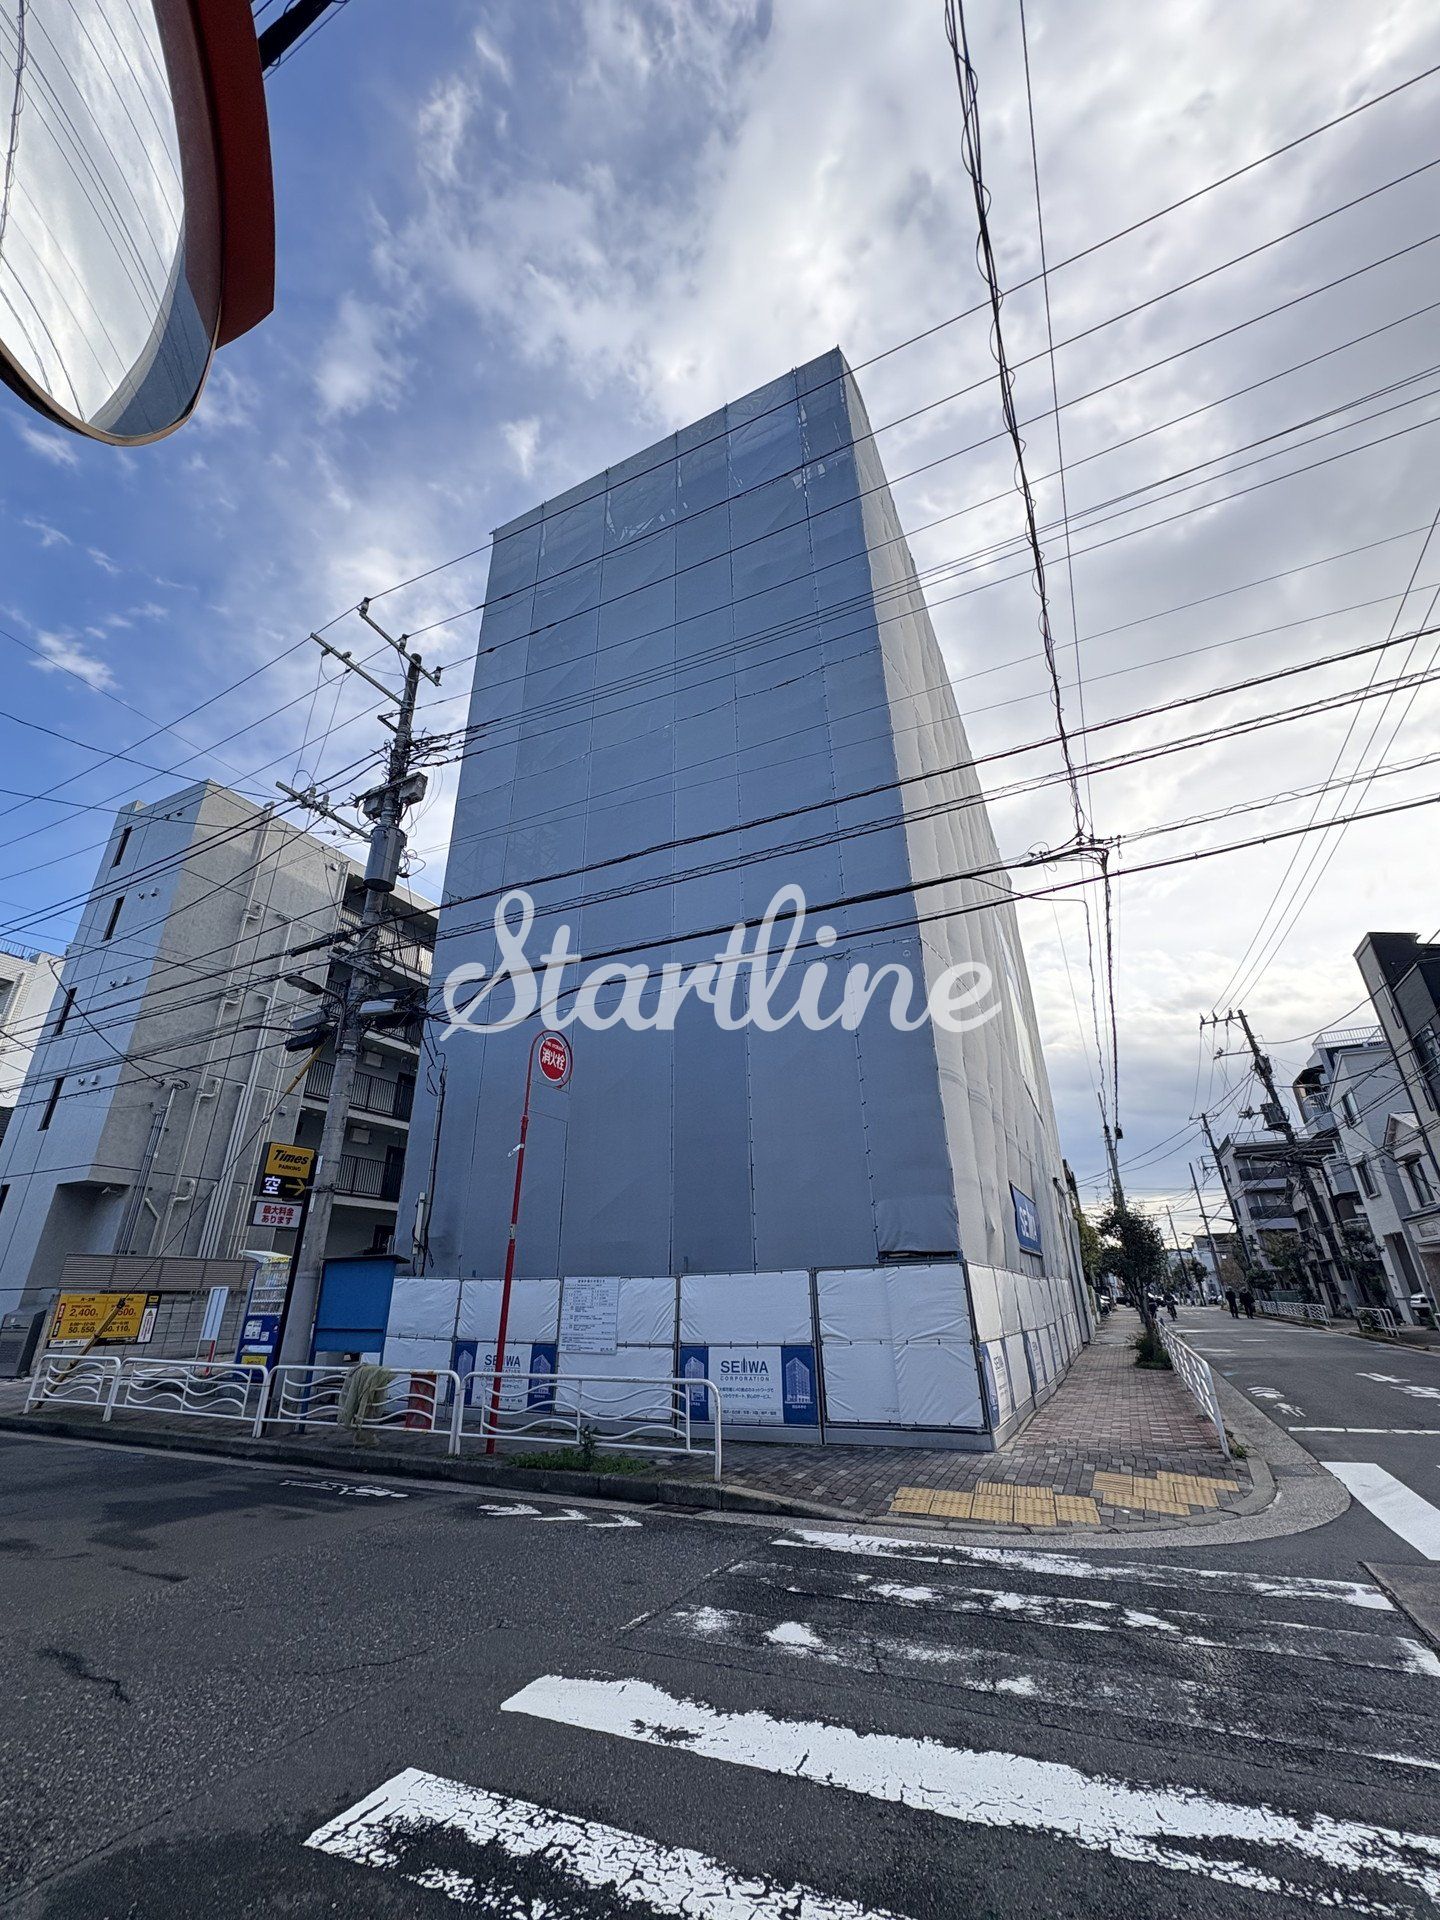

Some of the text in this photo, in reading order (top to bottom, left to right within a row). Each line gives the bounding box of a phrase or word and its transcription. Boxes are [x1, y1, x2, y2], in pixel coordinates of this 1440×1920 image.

[273, 1149, 309, 1165] Times
[263, 1176, 281, 1194] 空
[263, 1205, 294, 1216] 最大料金
[261, 1214, 293, 1225] あります
[720, 1356, 768, 1373] SEIWA
